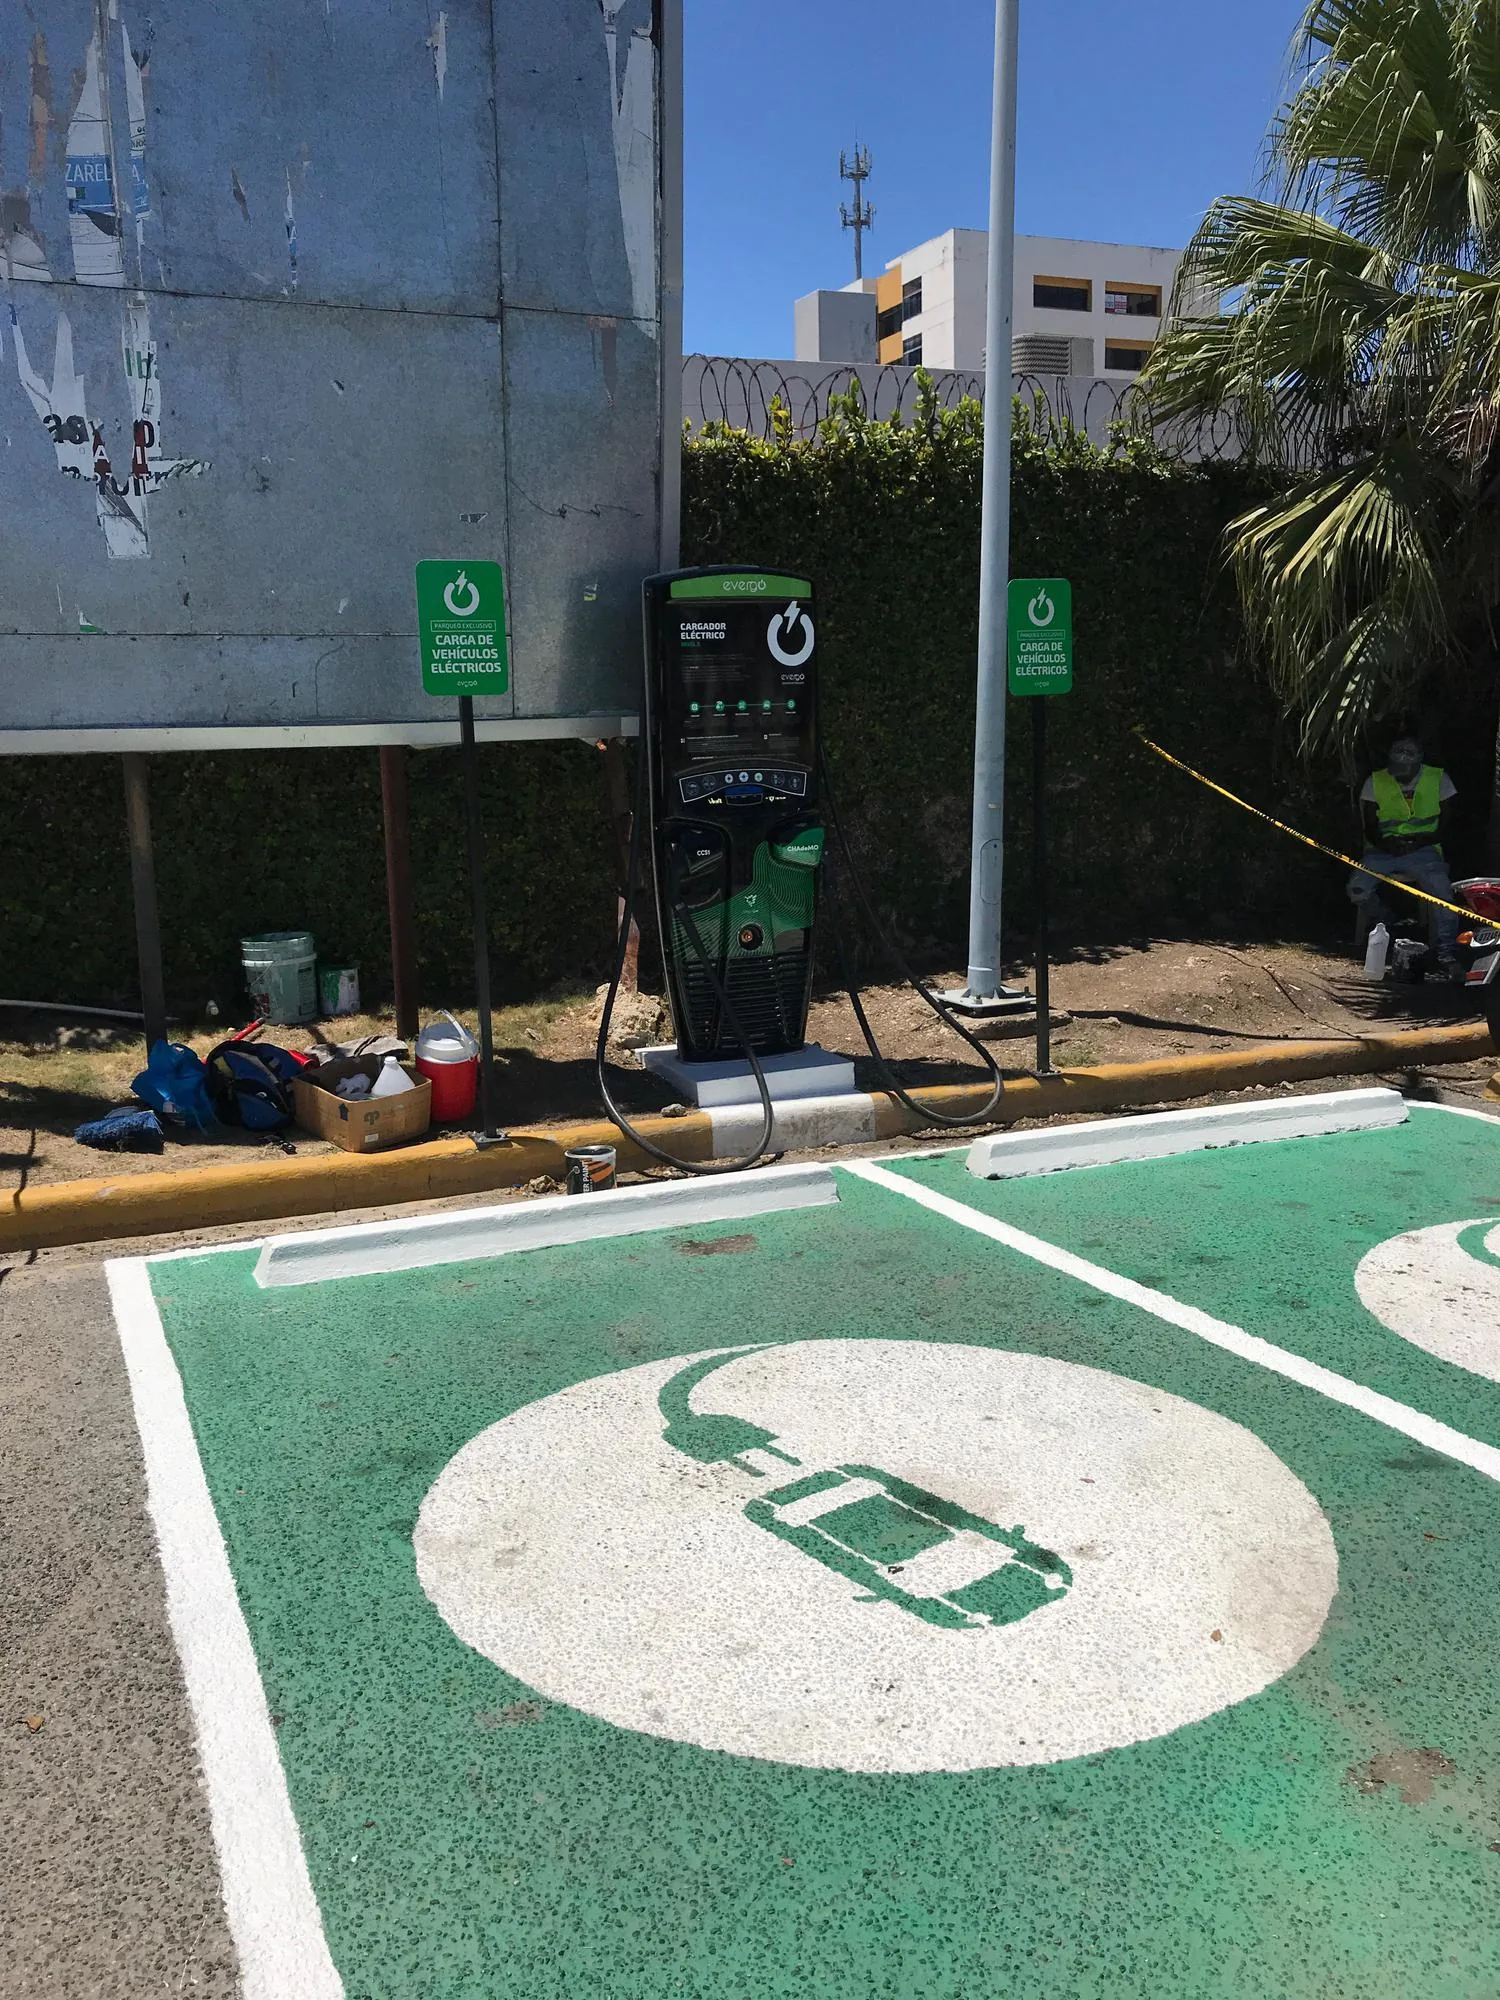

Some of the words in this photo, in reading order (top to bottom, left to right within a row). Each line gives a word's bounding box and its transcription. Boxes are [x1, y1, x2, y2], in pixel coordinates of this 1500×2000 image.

[680, 622, 726, 631] CARGADOR
[435, 634, 476, 645] CARGA
[477, 634, 494, 645] DE
[680, 630, 725, 640] ELÉCTRICO
[431, 645, 499, 660] VEHÍCULOS
[1020, 642, 1050, 652] CARGA
[1051, 642, 1063, 651] DE
[1017, 651, 1066, 664] VEHÍCULOS
[430, 660, 502, 674] ELÉCTRICOS
[1015, 663, 1068, 676] ELÉCTRICOS
[787, 844, 819, 852] CHAdeMO
